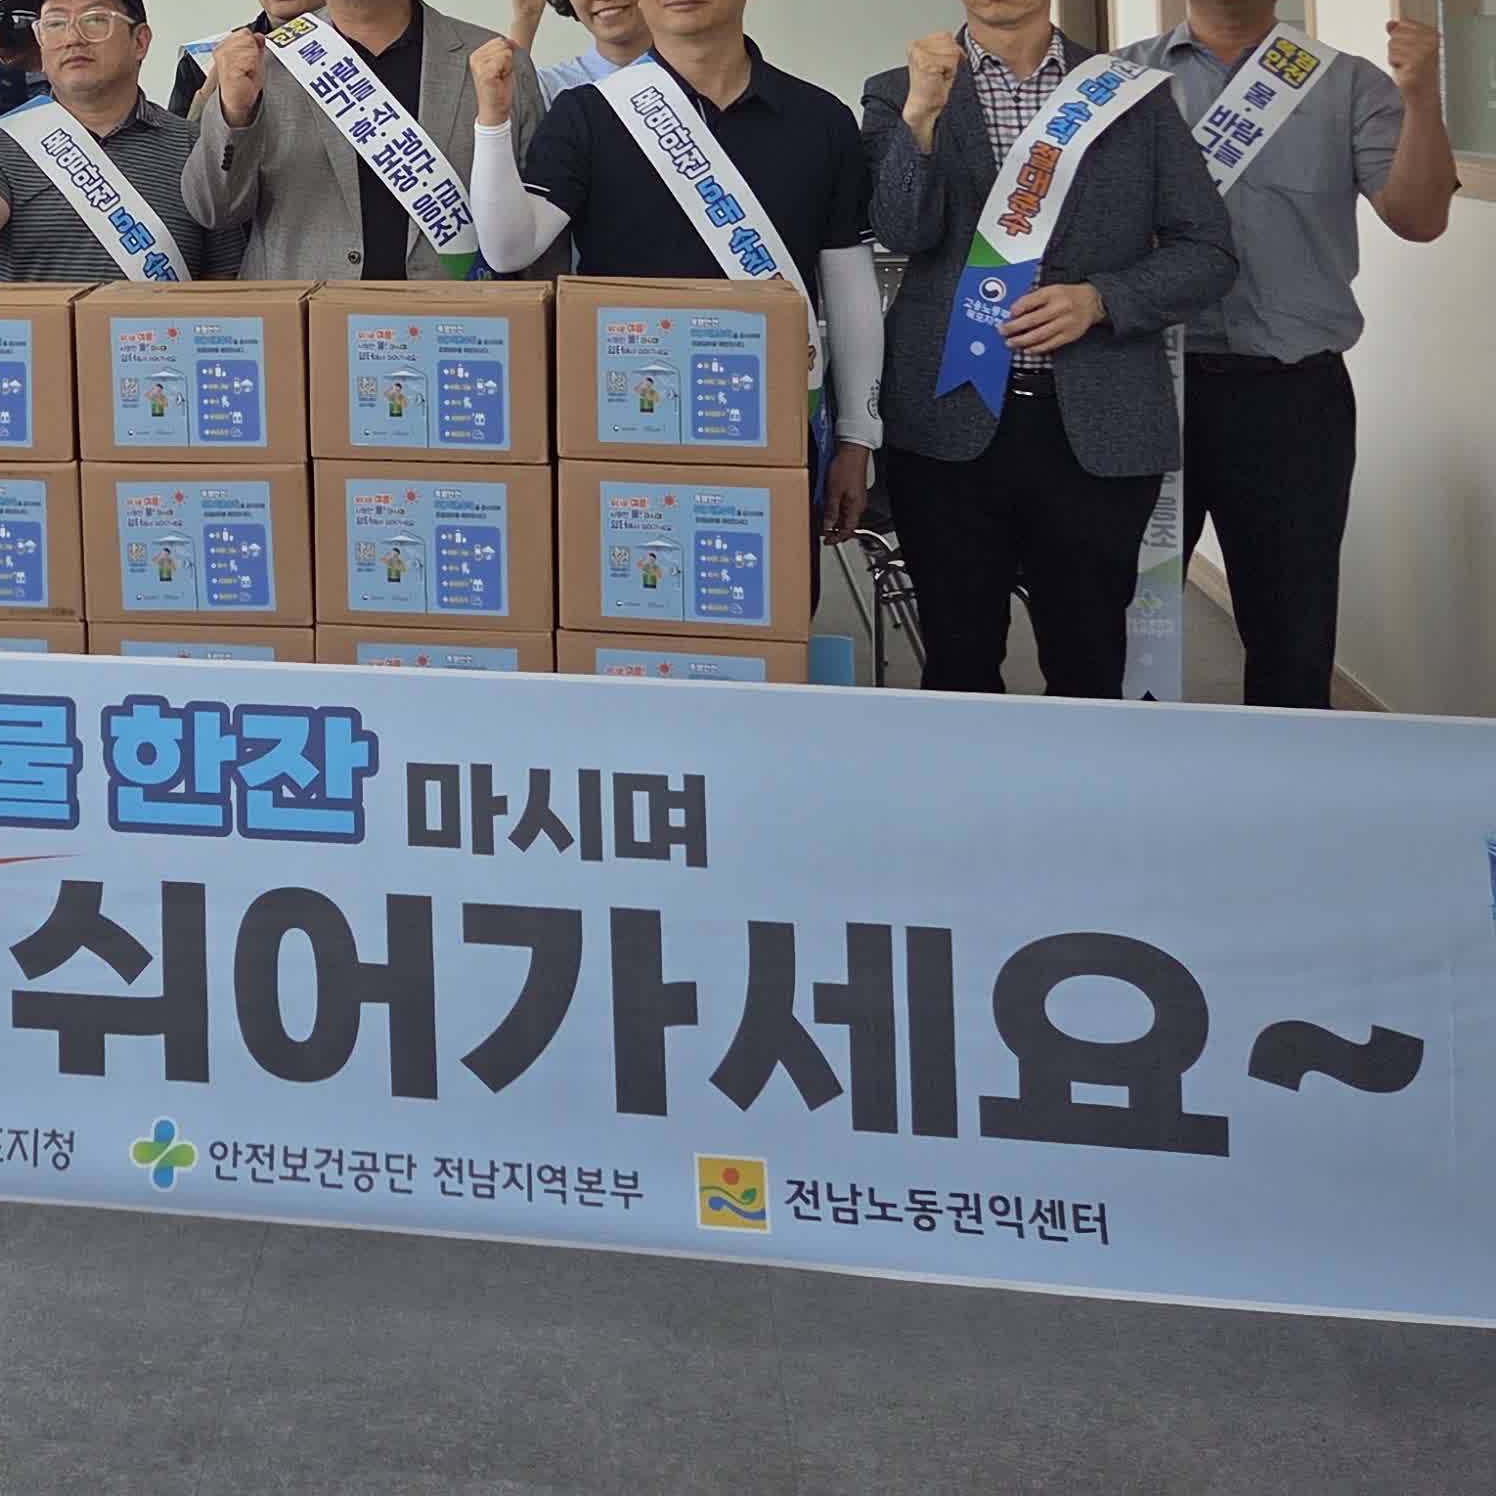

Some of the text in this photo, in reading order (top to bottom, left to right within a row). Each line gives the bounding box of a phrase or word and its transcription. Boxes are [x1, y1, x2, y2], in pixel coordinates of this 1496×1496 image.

[108, 206, 156, 255] 5대
[142, 251, 179, 281] 수
[694, 174, 747, 229] 5대
[727, 225, 778, 277] 수칙
[100, 694, 379, 845] 한잔
[405, 761, 708, 869] 마시며
[11, 880, 1424, 1158] 쉬어가세요~
[208, 1139, 417, 1196] 안전보건공단
[432, 1155, 644, 1209] 전남지역본부
[784, 1177, 1112, 1247] 전남노동권익센터
